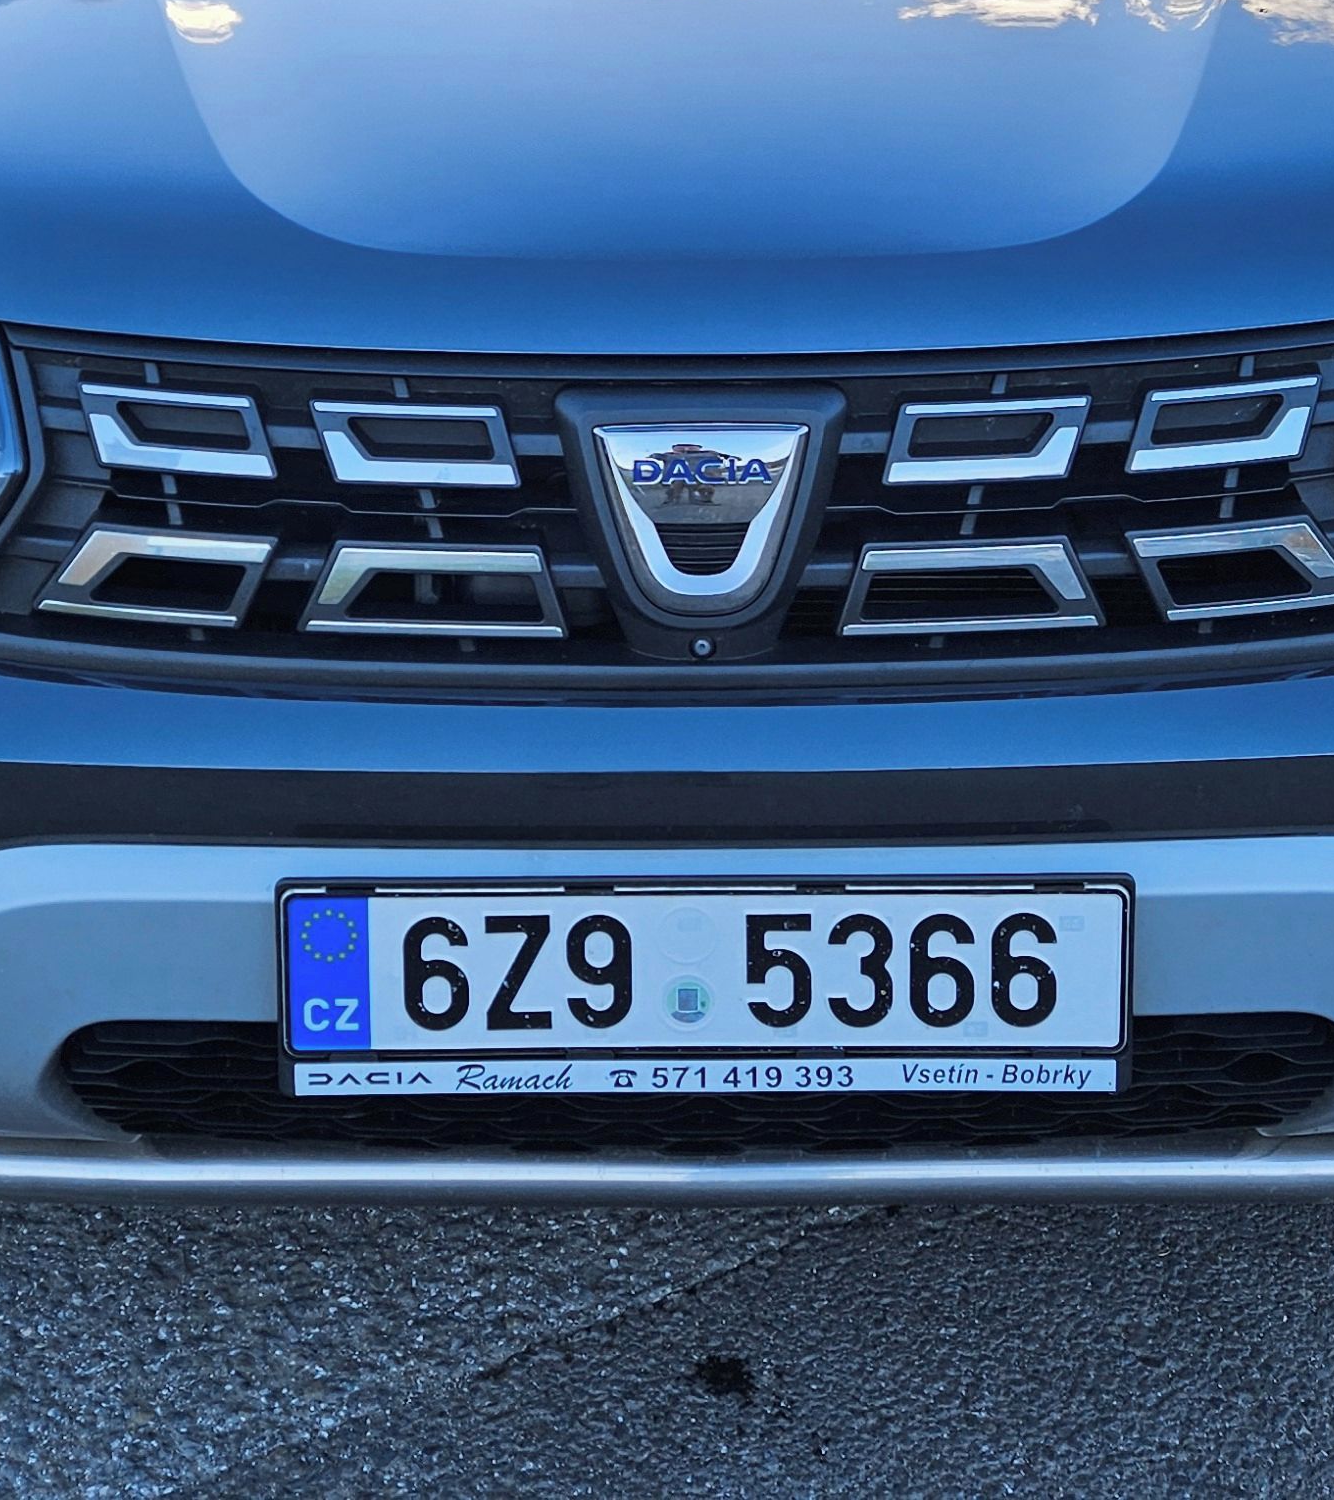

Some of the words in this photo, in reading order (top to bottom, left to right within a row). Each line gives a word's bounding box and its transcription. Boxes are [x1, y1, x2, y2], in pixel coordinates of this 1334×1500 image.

[632, 458, 772, 486] DACIA
[403, 914, 633, 1031] 6Z9
[745, 912, 1058, 1028] 5366
[303, 997, 360, 1033] CZ
[308, 1071, 432, 1086] DACIA
[455, 1063, 575, 1092] Ramach
[651, 1066, 708, 1089] 571
[723, 1066, 783, 1088] 419
[794, 1065, 855, 1087] 393
[901, 1063, 979, 1085] Vsetín
[1001, 1063, 1092, 1089] Bobrky
